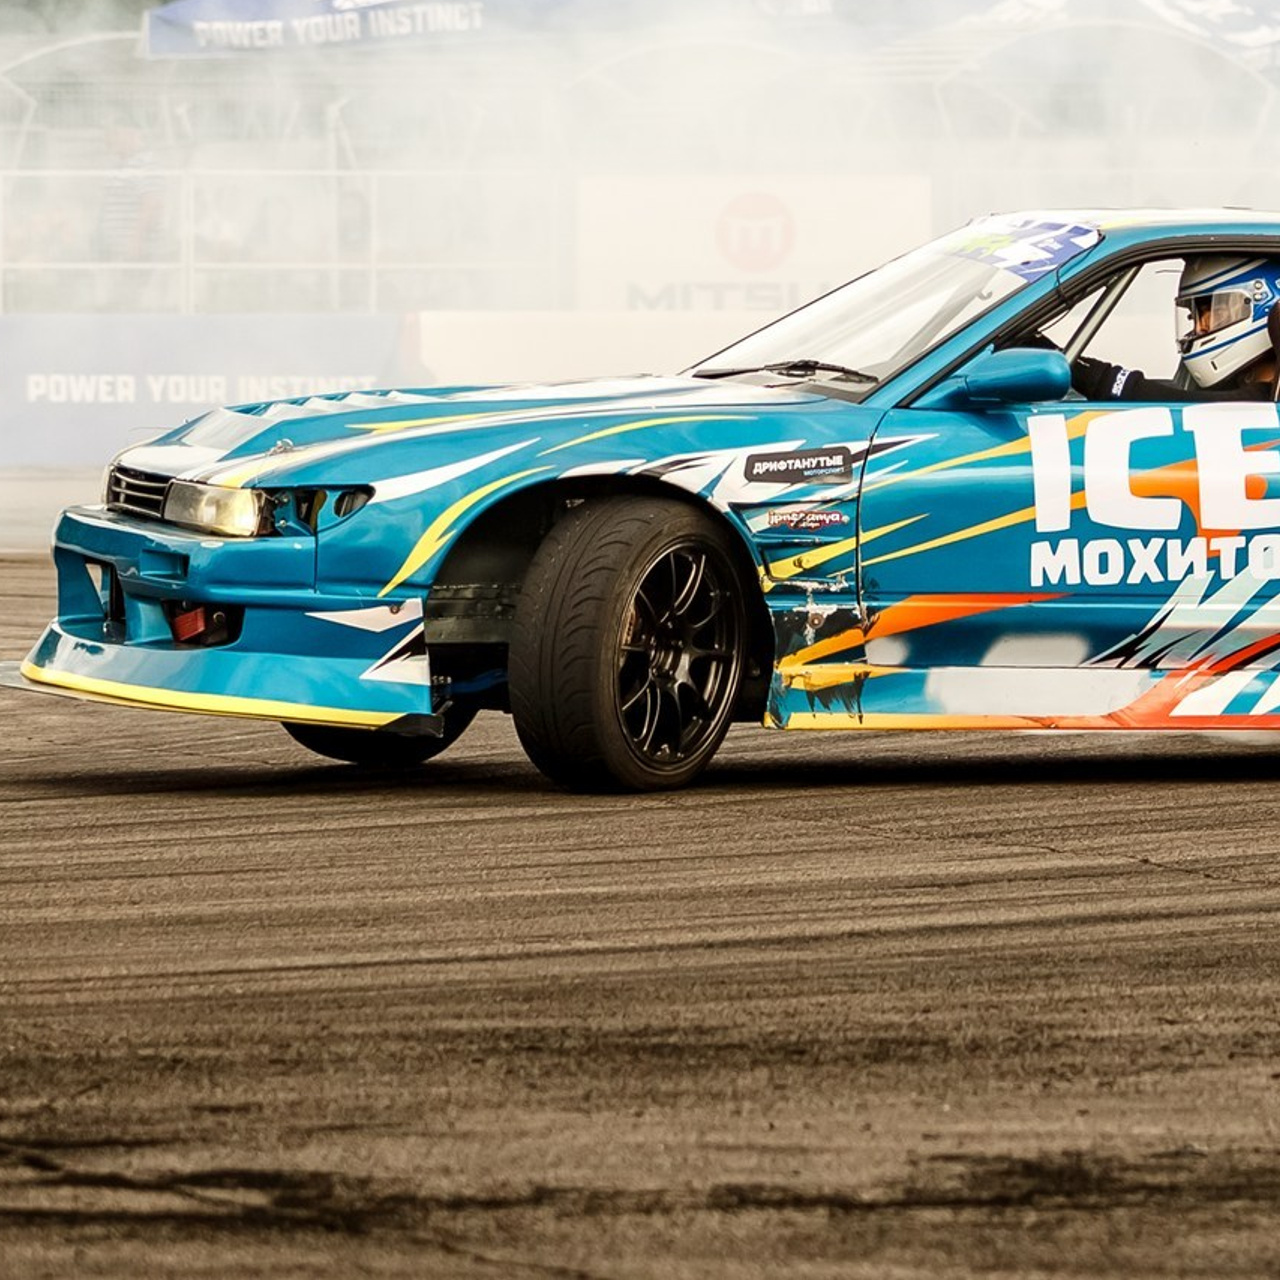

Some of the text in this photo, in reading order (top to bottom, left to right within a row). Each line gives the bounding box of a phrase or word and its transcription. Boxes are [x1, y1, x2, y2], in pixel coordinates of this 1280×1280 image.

[192, 1, 484, 47] POWER YOUR INSTINCT
[26, 374, 136, 403] POWER
[147, 374, 228, 403] YOUR
[753, 455, 844, 475] ДРИФТАНУТЫЕ
